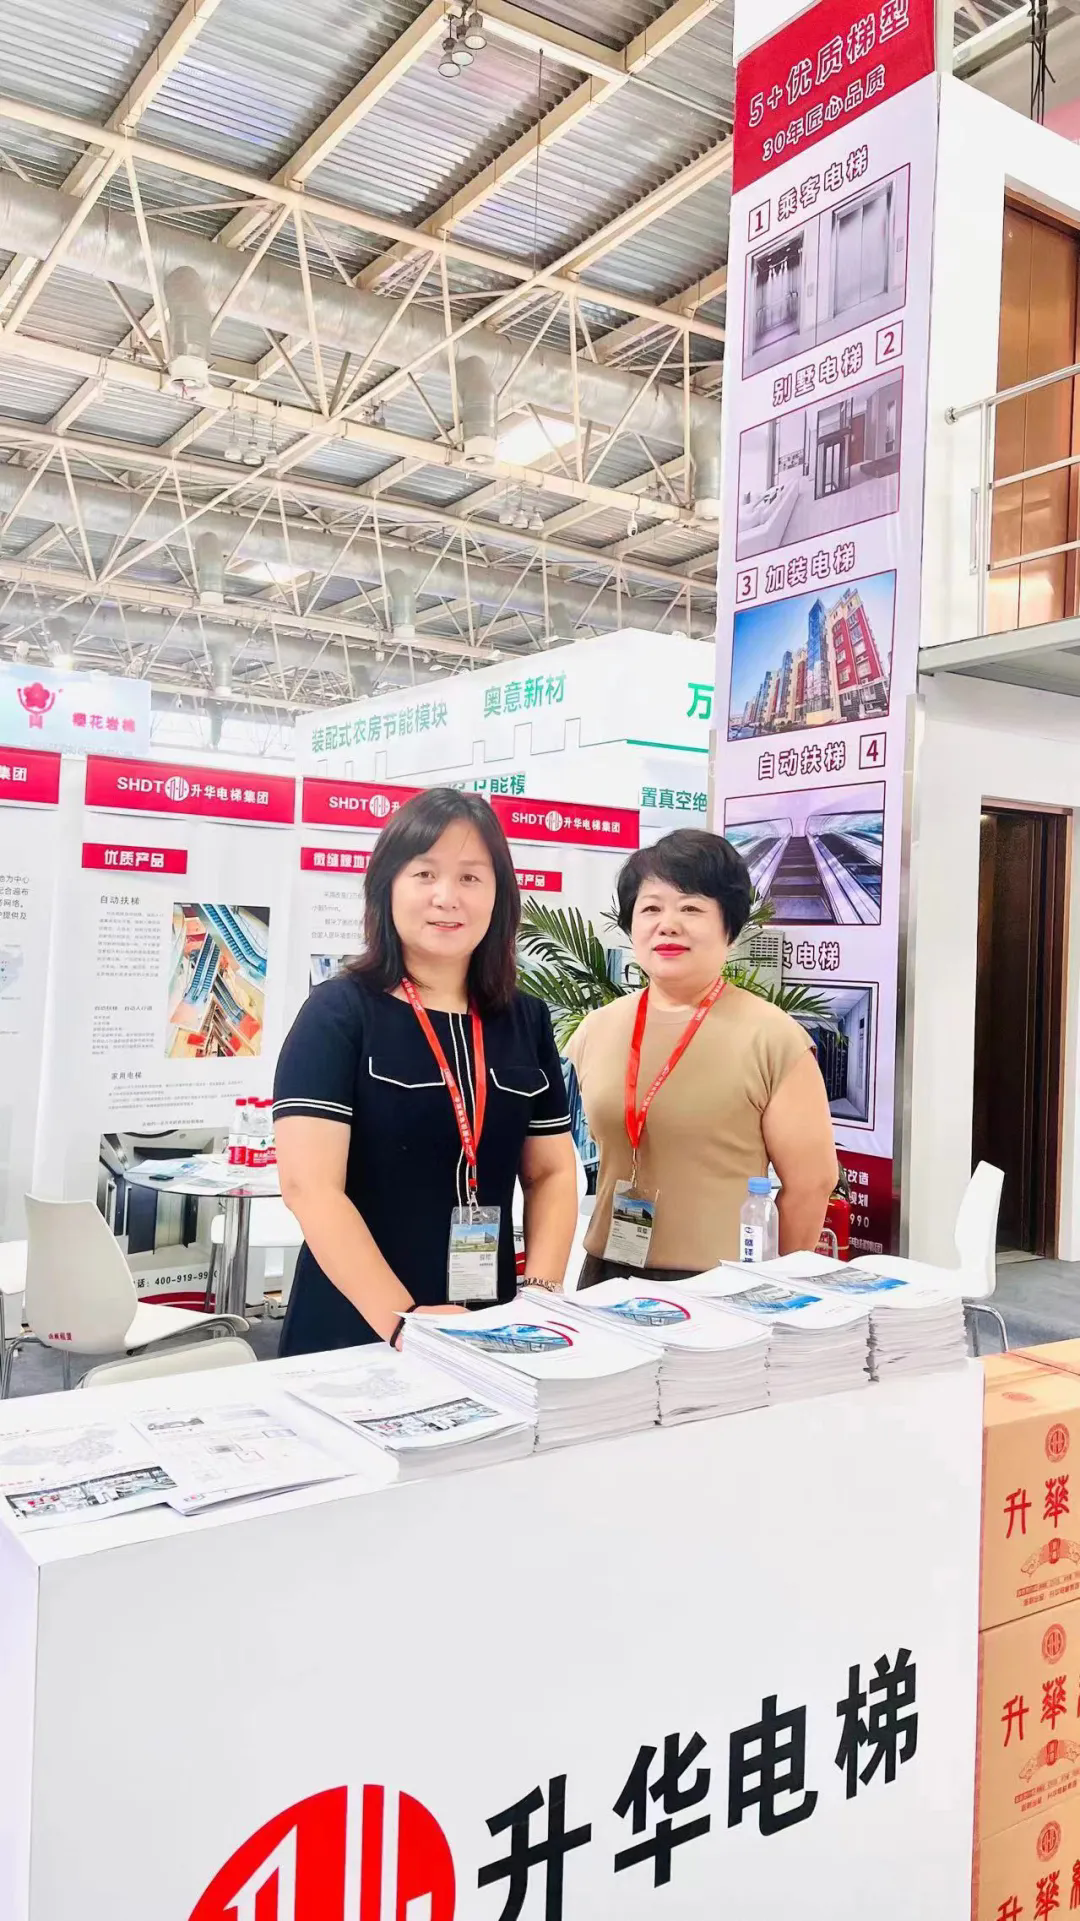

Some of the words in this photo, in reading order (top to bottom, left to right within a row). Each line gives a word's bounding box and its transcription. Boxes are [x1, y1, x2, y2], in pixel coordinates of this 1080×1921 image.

[748, 0, 910, 127] 5+优质梯型
[762, 64, 887, 162] 30年匠心品质
[754, 210, 763, 231] 1
[778, 145, 869, 221] 乘客电梯
[773, 343, 864, 407] 别墅电梯
[883, 331, 895, 356] 2
[741, 576, 751, 596] 3
[765, 542, 856, 594] 加装电梯
[312, 700, 447, 753] 装配式农房节能模块
[484, 671, 568, 718] 奥意新材
[758, 741, 846, 780] 自动扶梯
[866, 739, 879, 762] 4
[117, 776, 163, 795] SHDT
[190, 782, 269, 806] 升华电梯集团
[329, 796, 369, 812] SHDT
[511, 811, 545, 826] SHDT
[563, 817, 621, 835] 升华电梯集团
[104, 849, 165, 868] 优质产品
[100, 895, 140, 905] 自动扶梯
[478, 1647, 919, 1921] 升华电梯
